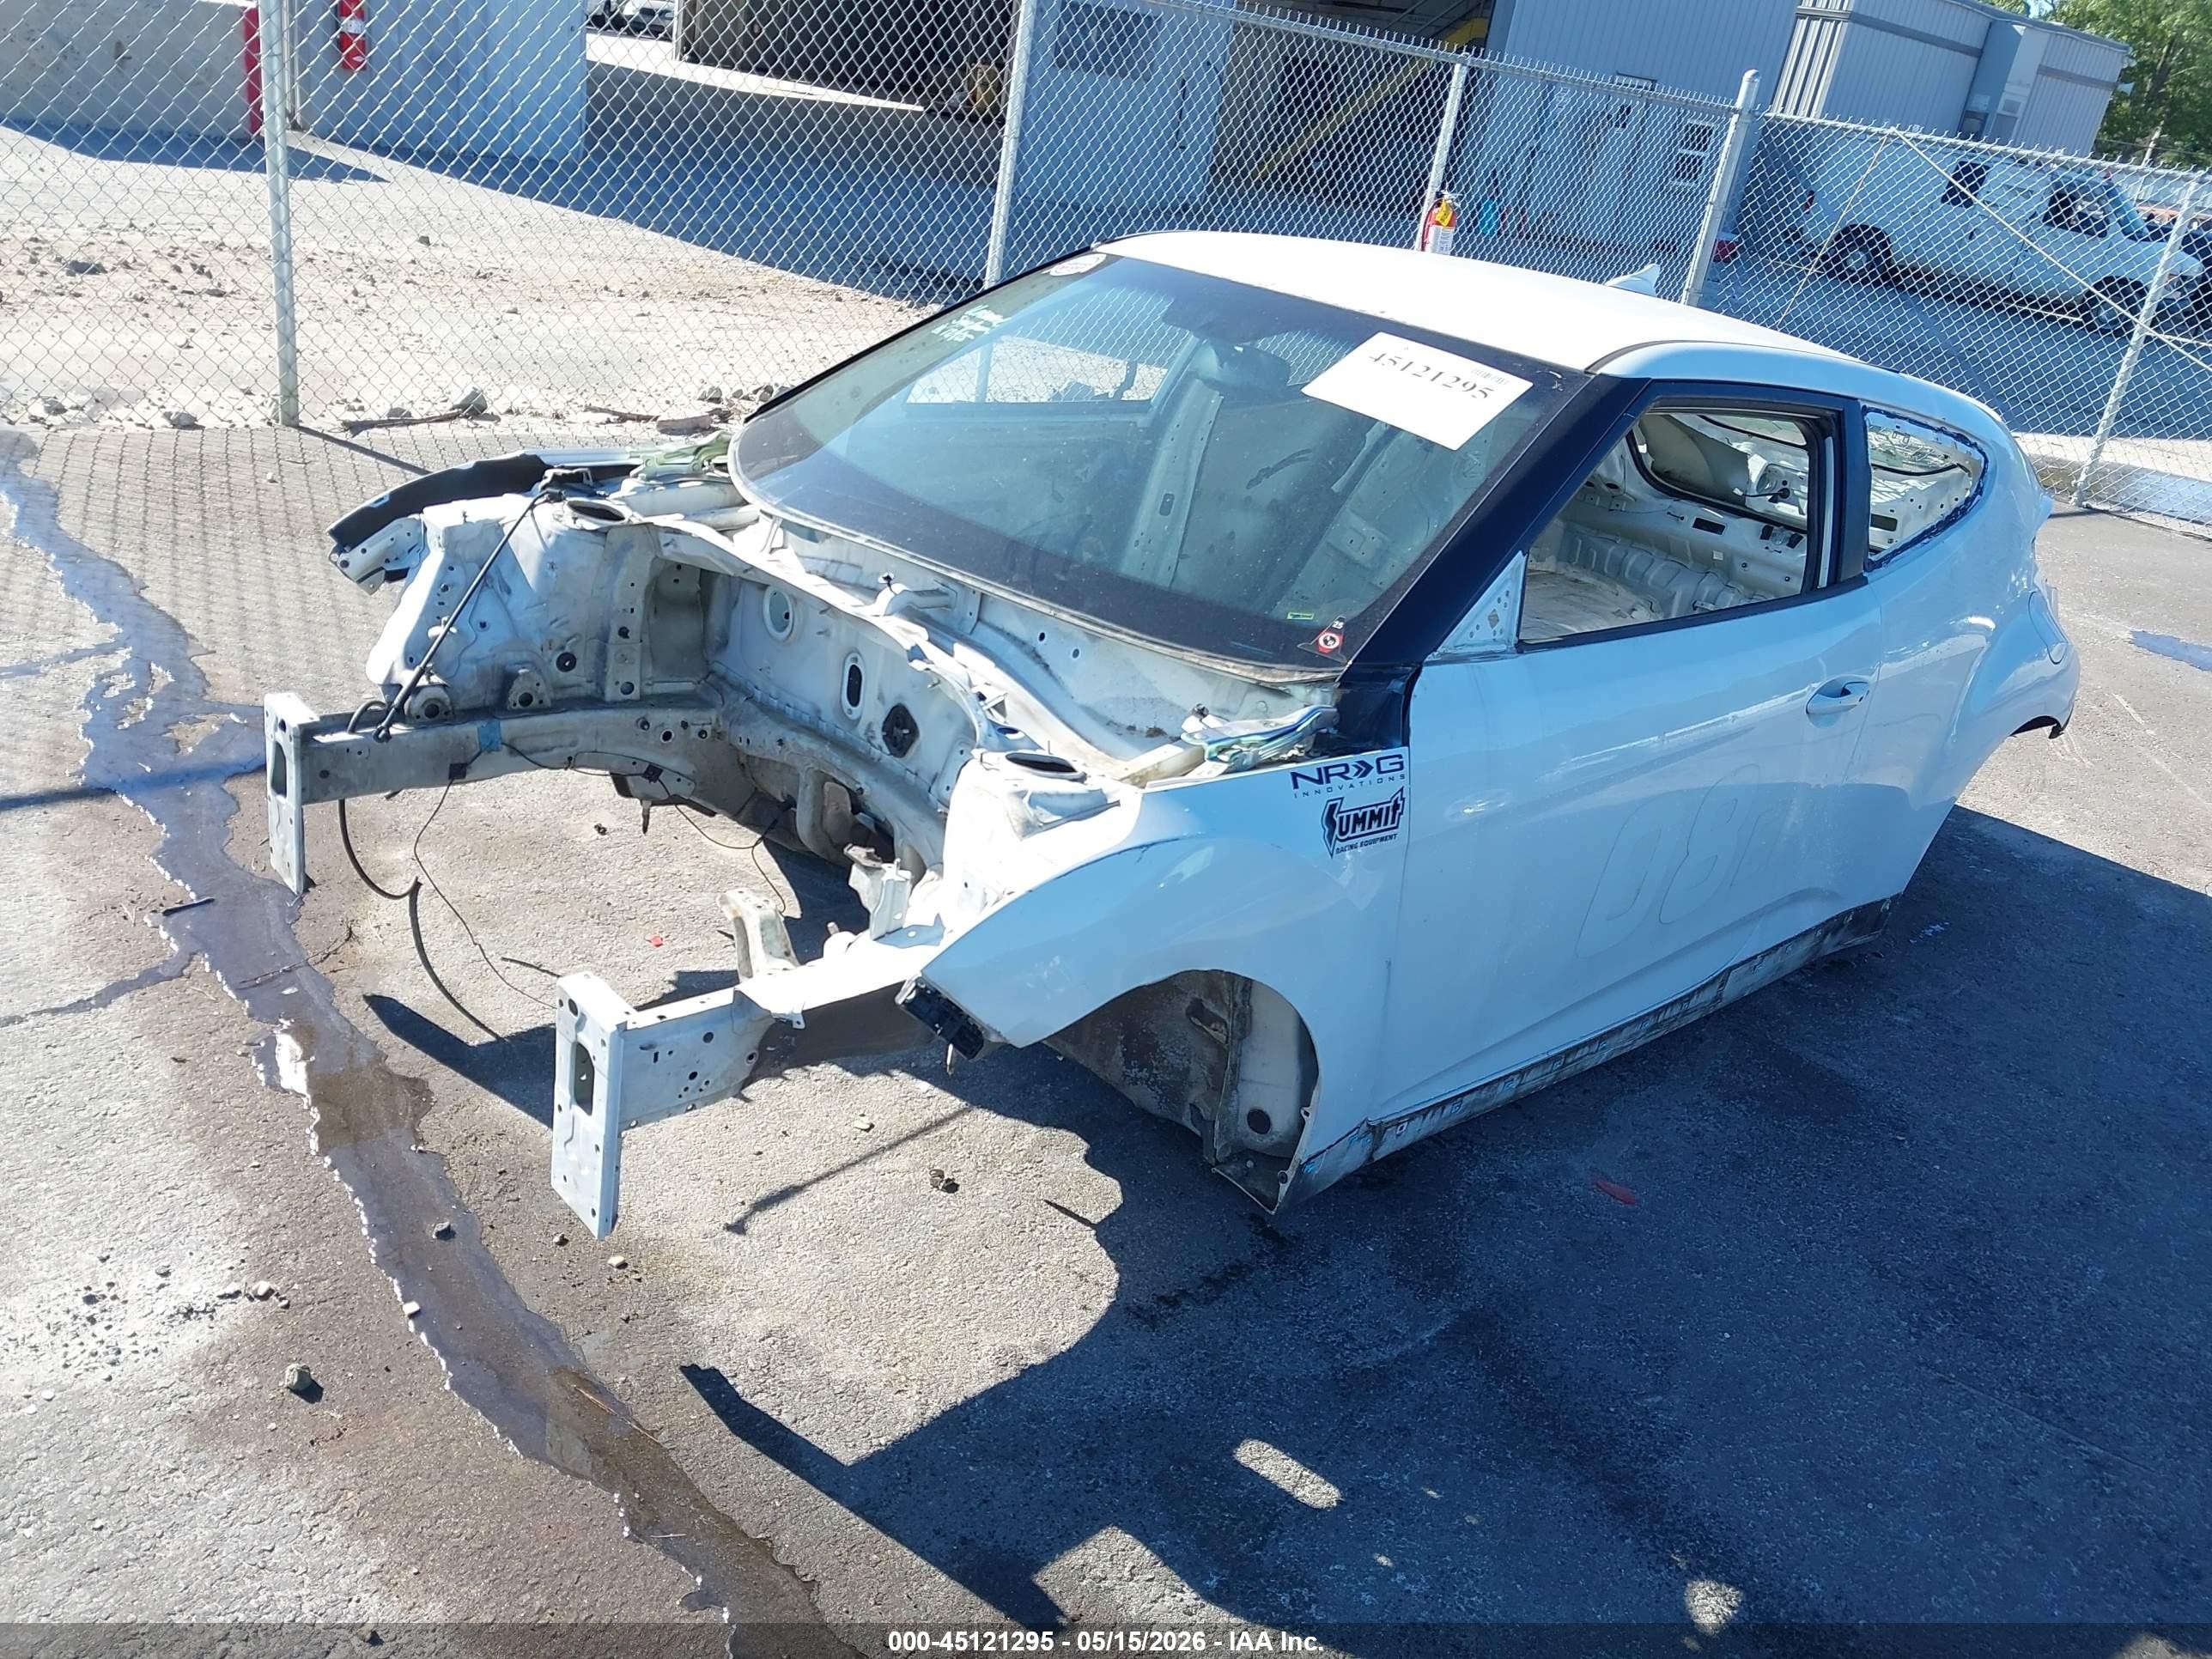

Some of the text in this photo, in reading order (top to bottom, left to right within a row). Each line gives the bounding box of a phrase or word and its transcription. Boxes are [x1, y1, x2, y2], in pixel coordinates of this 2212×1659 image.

[1368, 352, 1495, 399] 45121295
[1294, 774, 1406, 799] INNOVATIONS
[1359, 833, 1399, 848] EQUIPMENT
